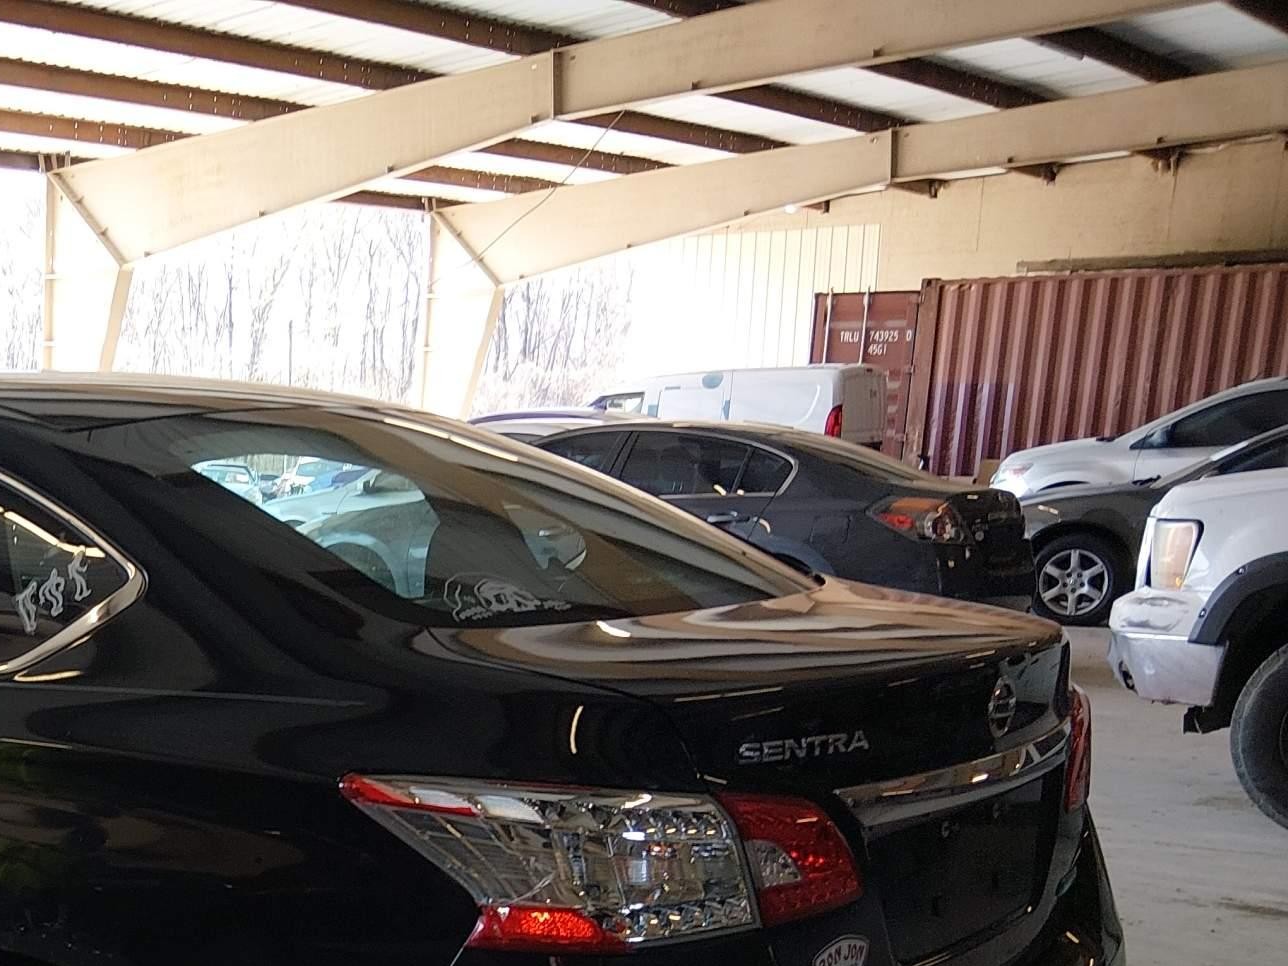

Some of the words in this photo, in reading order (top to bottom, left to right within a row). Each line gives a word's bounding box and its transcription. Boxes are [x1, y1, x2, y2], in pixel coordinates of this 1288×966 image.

[840, 330, 859, 343] TRLU
[869, 329, 899, 343] 743925
[867, 343, 888, 356] 45G1
[738, 730, 869, 765] SENTRA
[843, 943, 865, 961] JON
